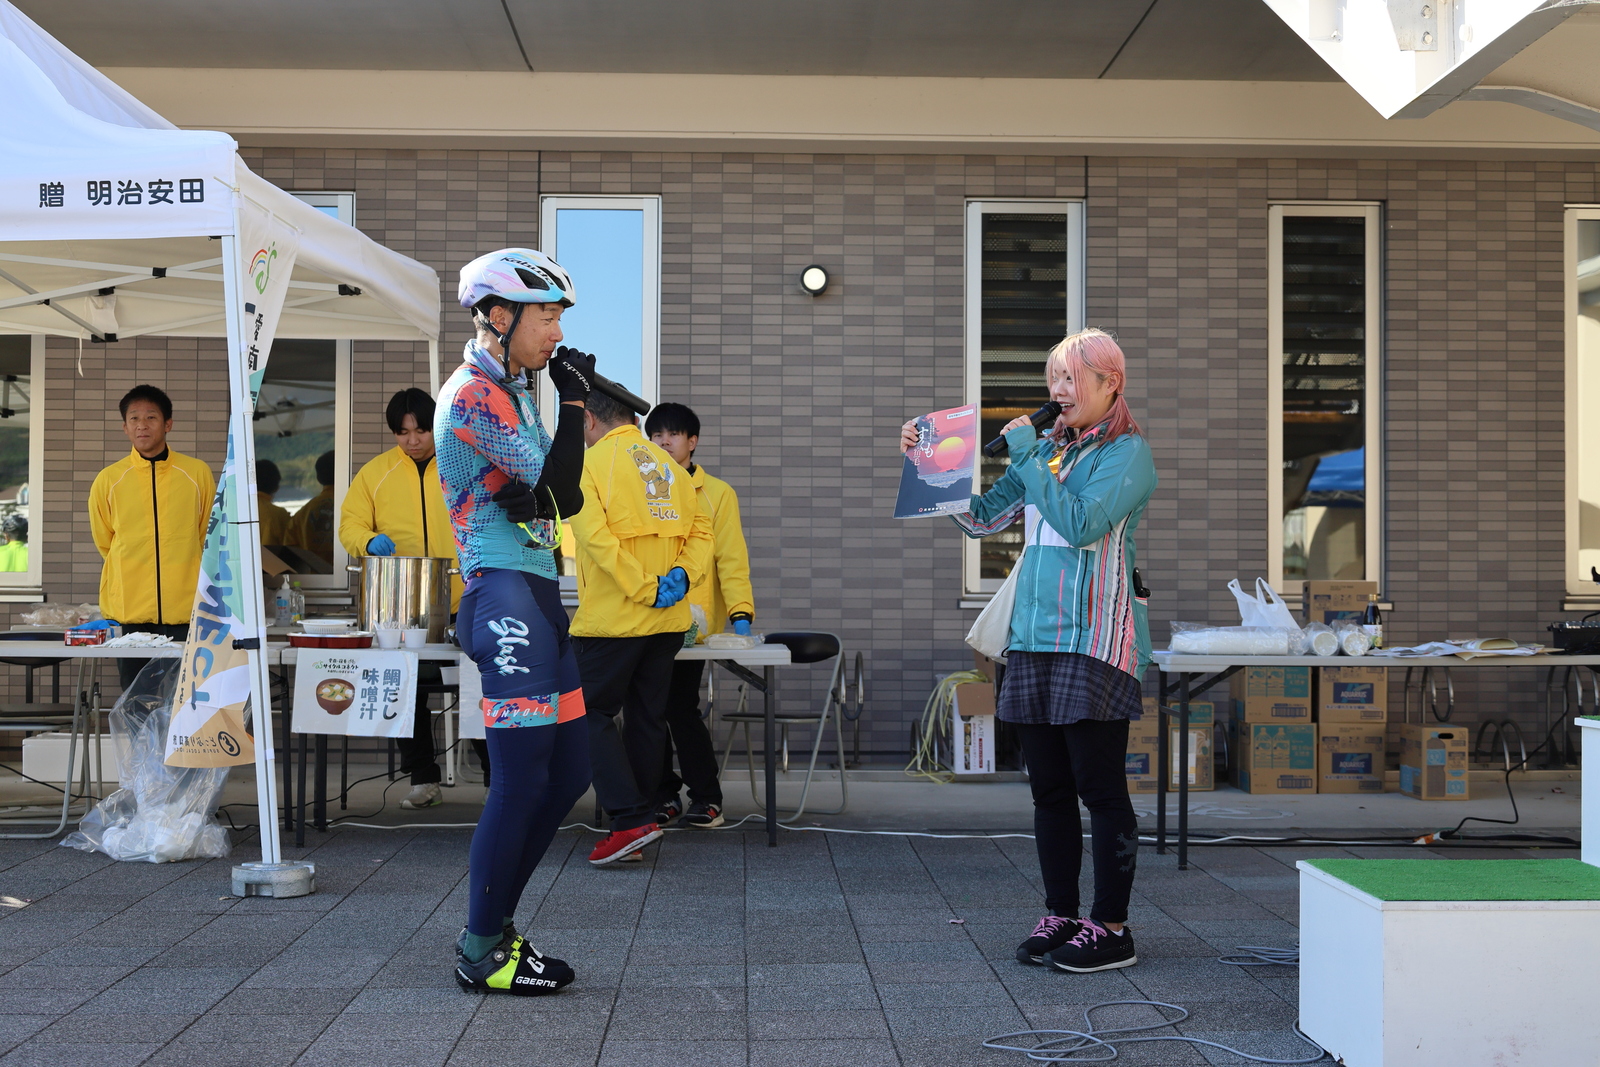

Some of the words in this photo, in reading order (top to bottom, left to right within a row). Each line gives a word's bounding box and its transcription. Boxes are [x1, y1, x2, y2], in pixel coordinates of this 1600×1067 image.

[39, 181, 65, 208] 贈
[86, 178, 205, 206] 明治安田
[500, 257, 555, 286] Kabuto
[562, 361, 591, 392] Kabuto
[500, 421, 539, 462] SUNVOLT
[359, 667, 380, 721] 味噌汁
[382, 668, 402, 721] 鯛だし
[1340, 690, 1367, 699] AQUARIUS
[486, 705, 549, 718] SUNVOLT
[1339, 761, 1365, 769] AQUARIUS
